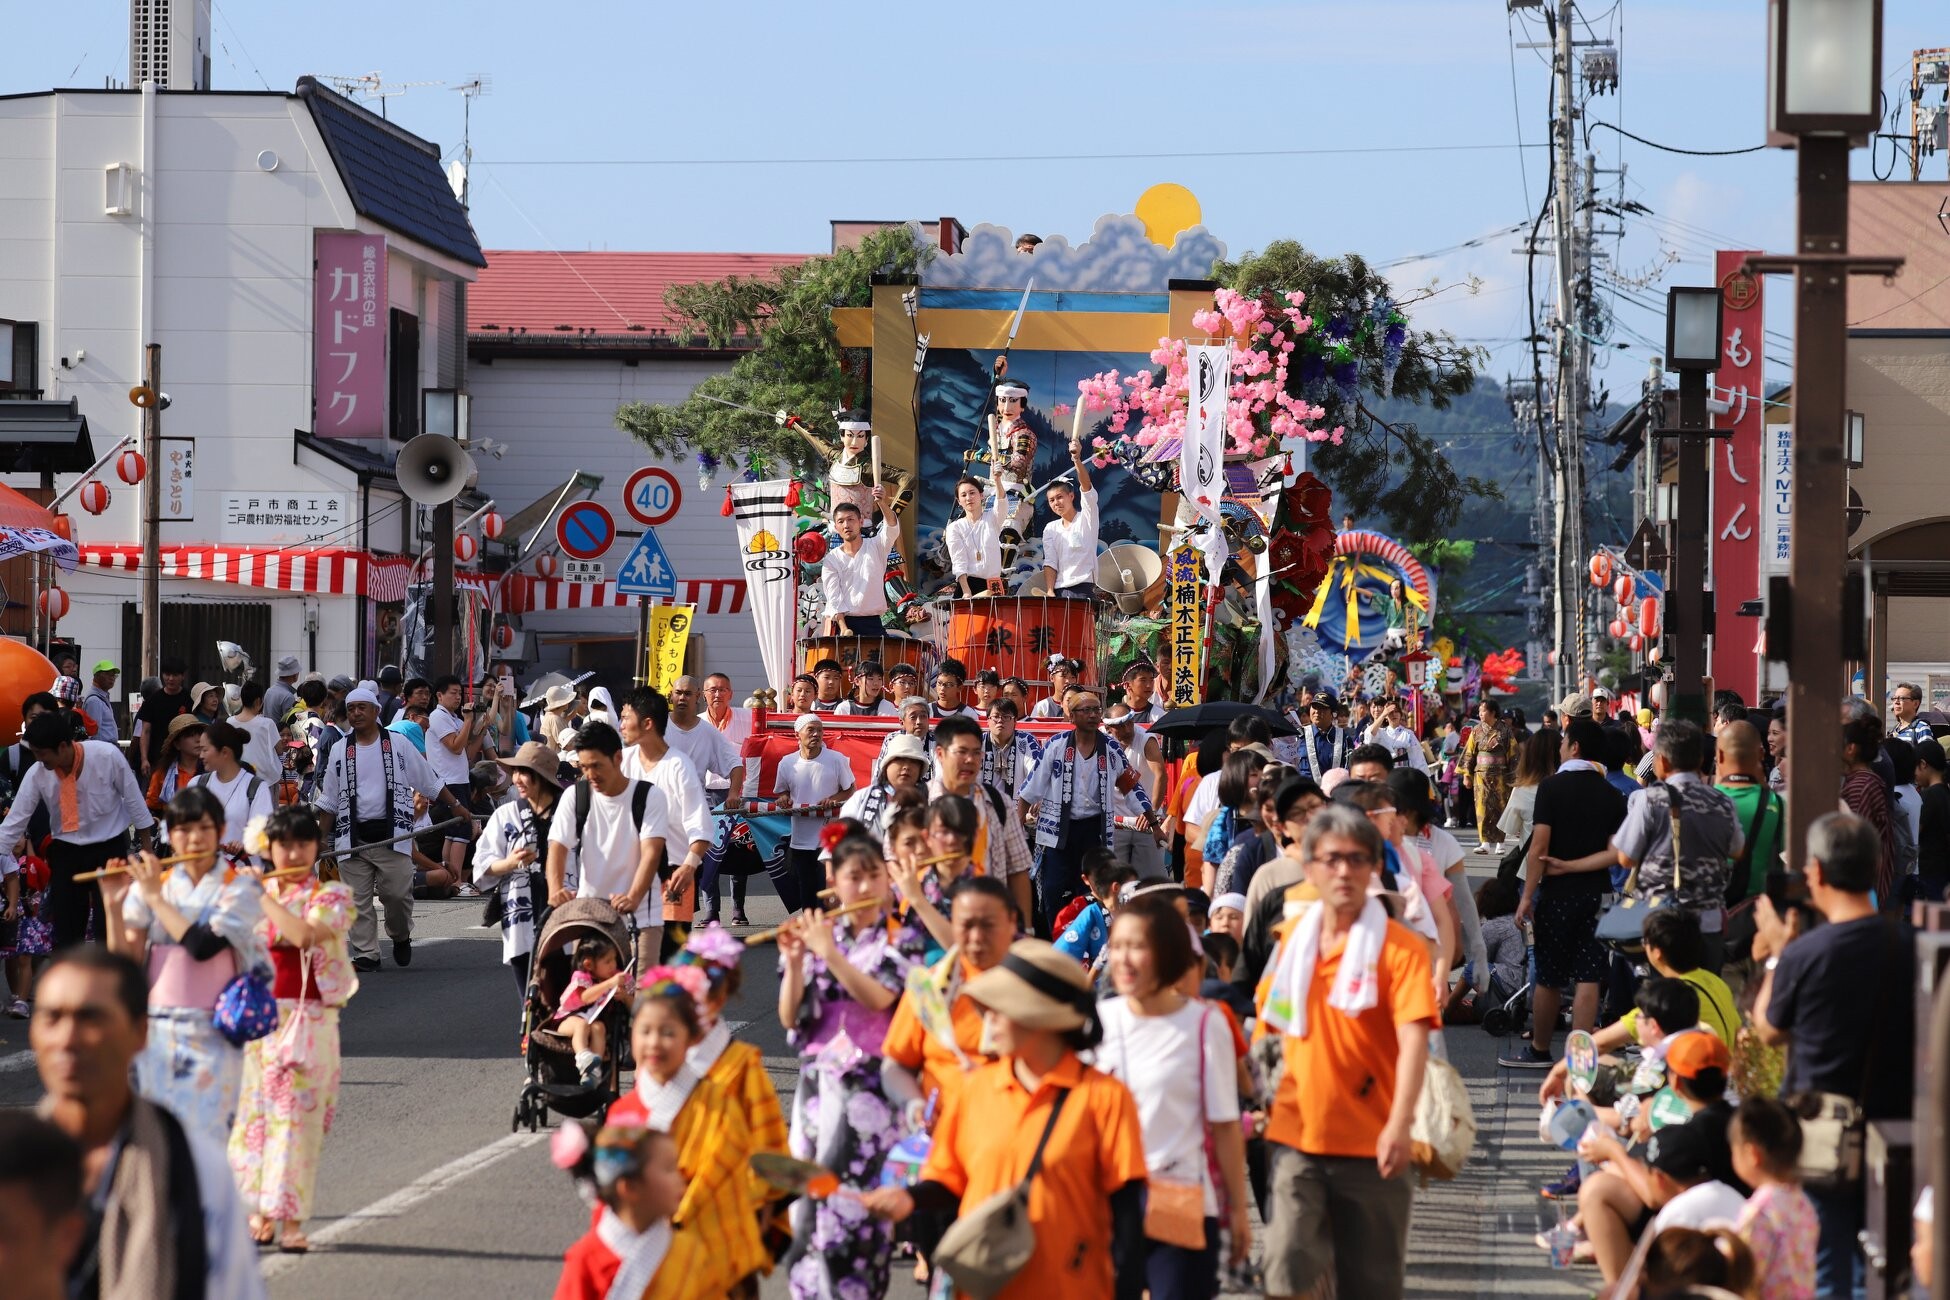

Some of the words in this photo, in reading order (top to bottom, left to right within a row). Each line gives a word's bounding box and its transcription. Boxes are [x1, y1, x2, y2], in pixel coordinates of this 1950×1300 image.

[362, 245, 376, 327] 総合衣料の店
[329, 267, 359, 426] カドフク
[1721, 327, 1752, 541] もりしん
[169, 450, 184, 515] やきとり
[228, 499, 339, 511] 二戸市商工会
[636, 484, 669, 510] 40
[227, 513, 339, 526] 二戸農村勤労福祉センター
[565, 574, 602, 583] 二輪を除く
[567, 562, 601, 572] 自動車
[1174, 548, 1197, 705] 風流楠木正行決戦
